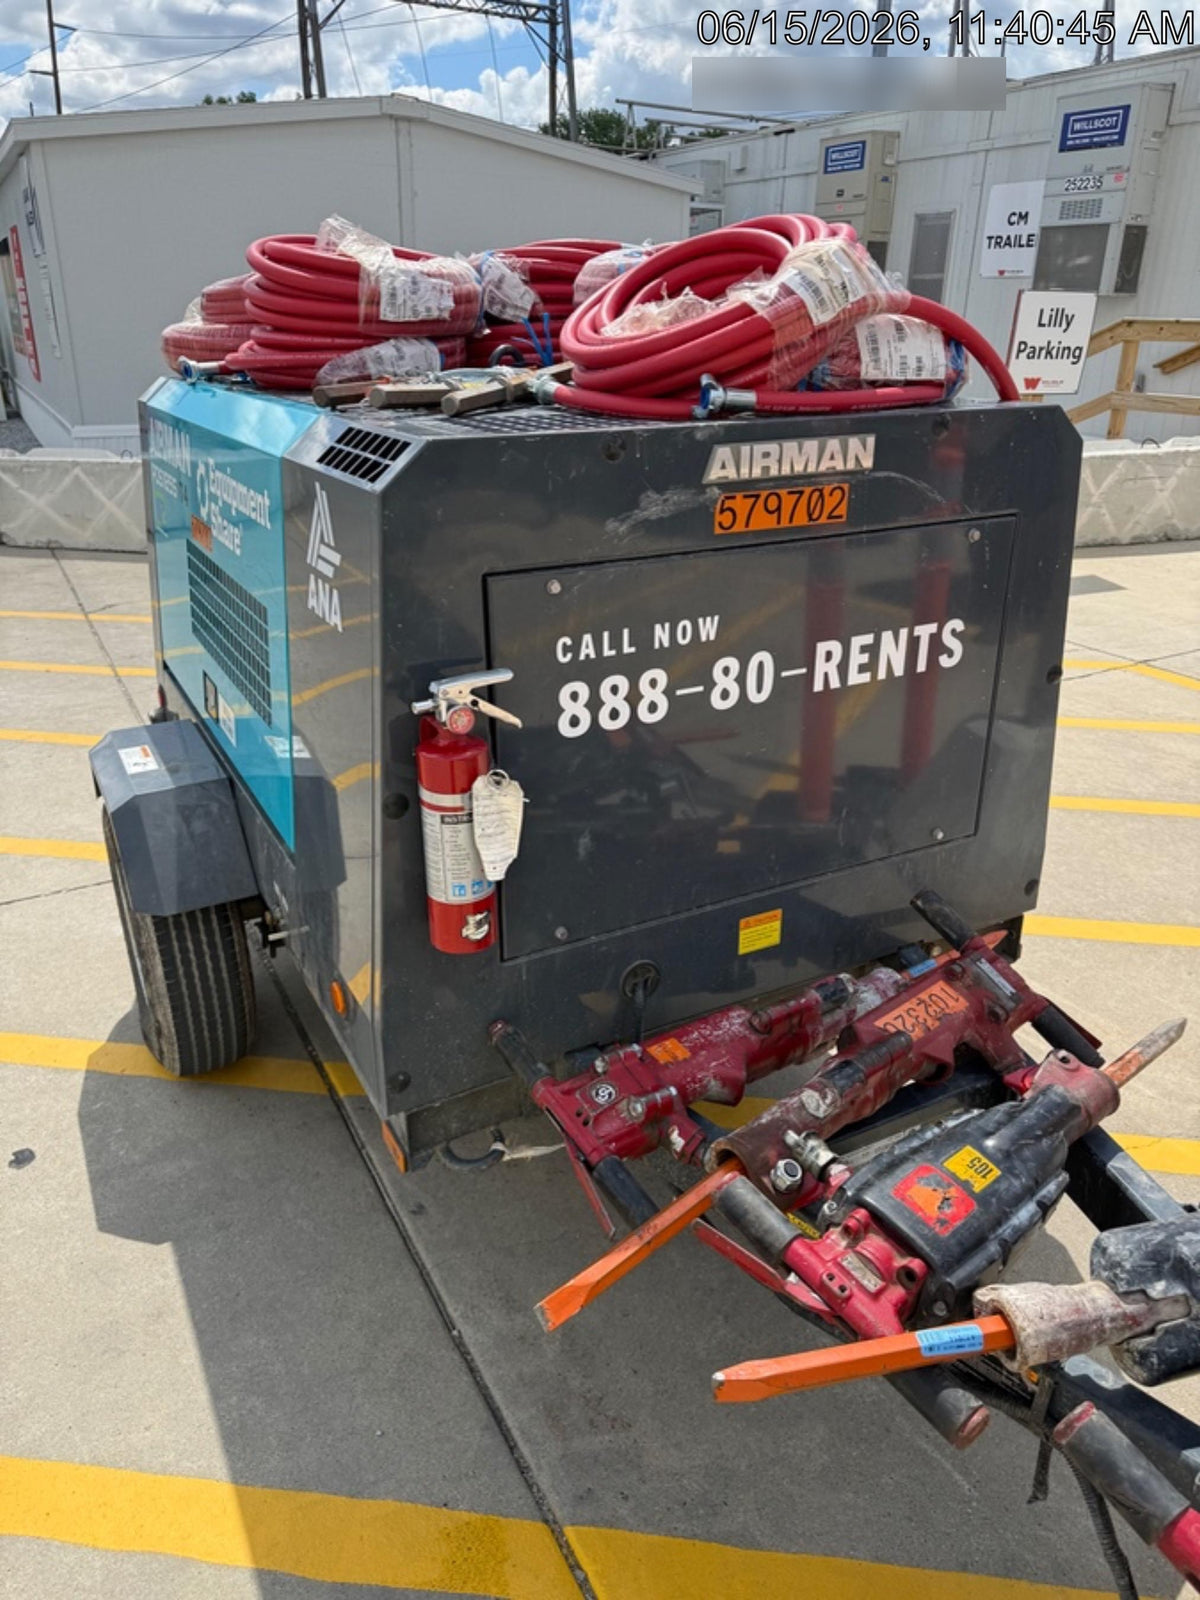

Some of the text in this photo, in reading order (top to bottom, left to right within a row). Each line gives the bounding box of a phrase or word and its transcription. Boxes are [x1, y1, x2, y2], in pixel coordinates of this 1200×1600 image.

[1073, 116, 1118, 132] WILLSCOT
[1063, 174, 1105, 193] 252235
[1007, 211, 1029, 226] CM
[1036, 308, 1075, 333] Lilly
[1015, 341, 1084, 365] Parking
[708, 437, 876, 481] AIRMAN
[207, 457, 271, 530] Equipment
[718, 485, 847, 531] 579702
[210, 502, 241, 556] Share
[307, 573, 342, 632] ANA
[556, 615, 720, 663] CALL NOW
[557, 618, 966, 739] 888-80-RENTS
[966, 1156, 994, 1179] 105
